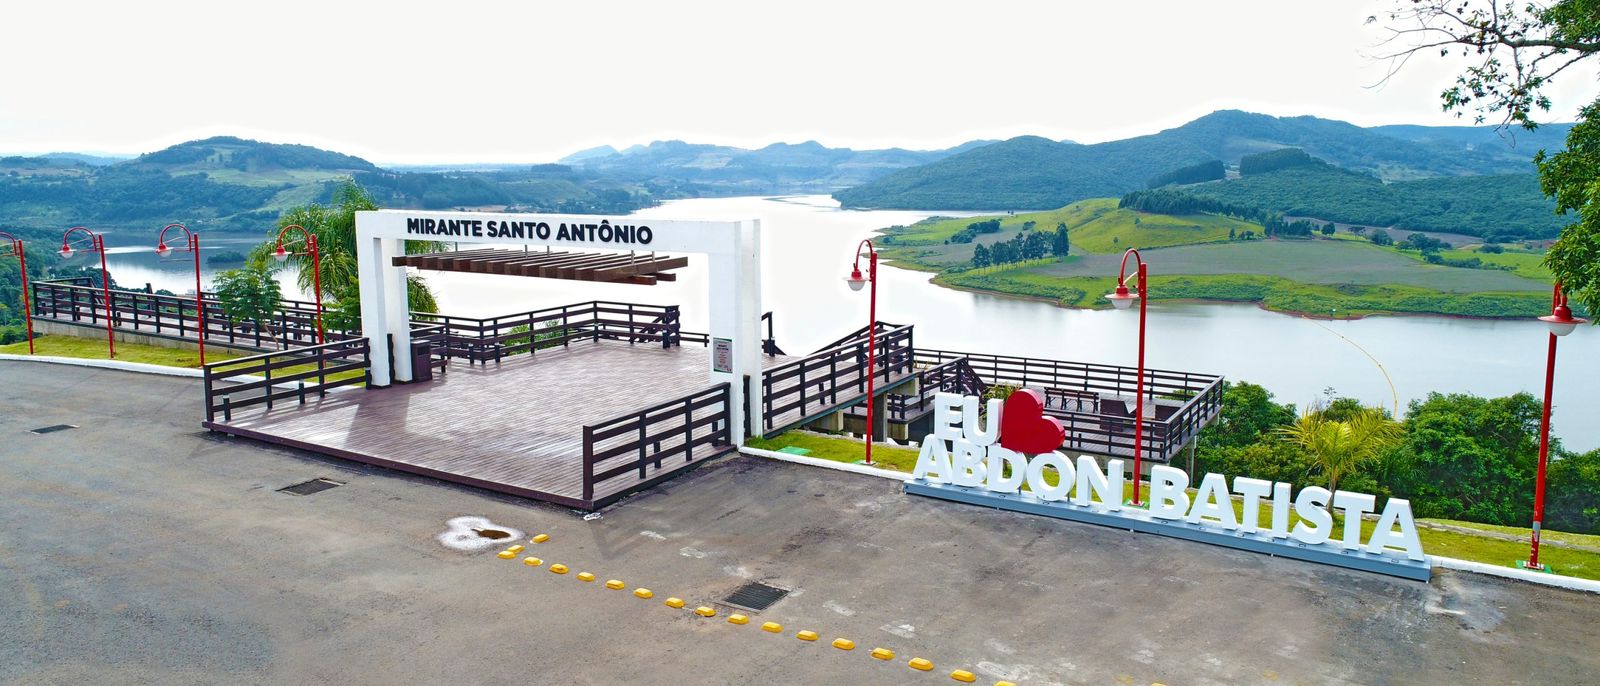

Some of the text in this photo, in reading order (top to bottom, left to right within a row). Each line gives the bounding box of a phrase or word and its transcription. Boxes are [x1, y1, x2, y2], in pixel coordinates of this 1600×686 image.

[407, 218, 653, 245] MIRANTE SANTO ANTÔNIO
[934, 391, 1002, 446] EU
[912, 433, 1424, 561] ABDON BATISTA
